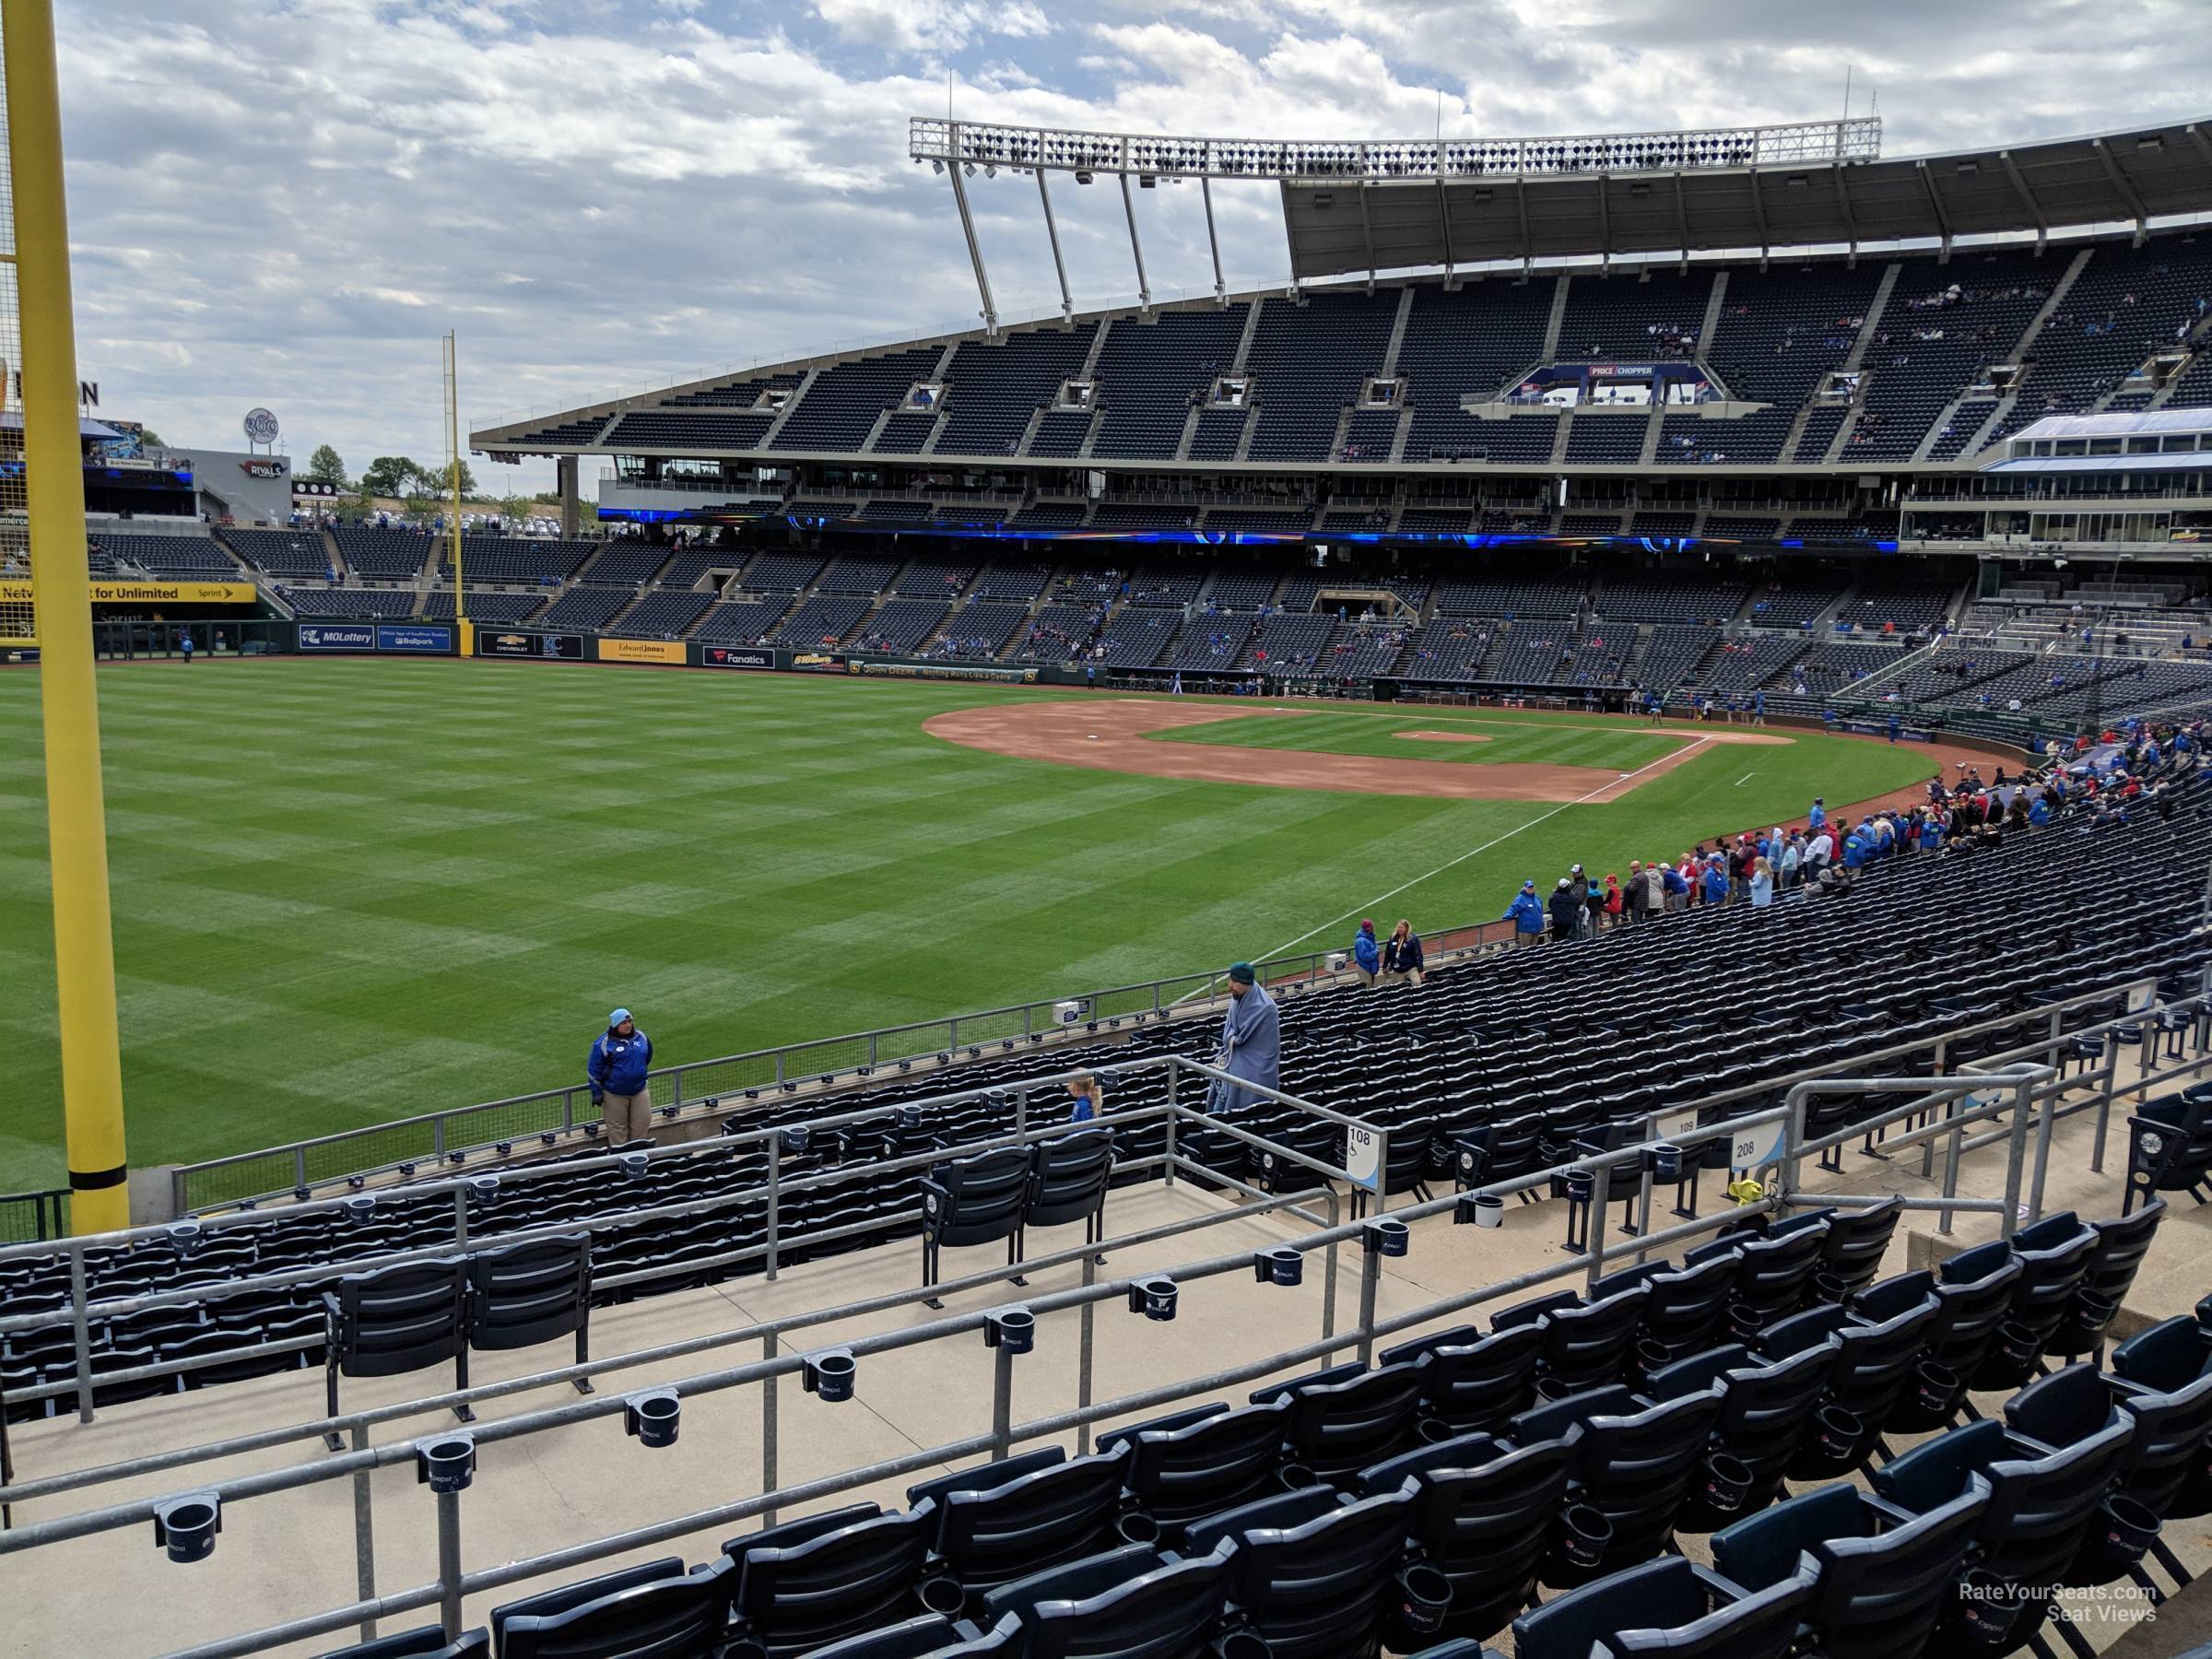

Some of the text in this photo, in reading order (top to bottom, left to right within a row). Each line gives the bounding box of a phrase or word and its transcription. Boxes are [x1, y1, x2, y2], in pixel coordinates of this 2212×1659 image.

[1592, 367, 1614, 375] PRICE
[246, 414, 278, 437] 360
[251, 465, 282, 477] RIVALS
[95, 587, 113, 599] for
[116, 587, 179, 599] Unlimited
[198, 589, 222, 599] Sprint
[323, 631, 372, 644] MOLottery
[403, 637, 433, 645] Ballpark
[618, 642, 665, 653] Edward Jones
[727, 653, 766, 665] Fanatics
[1679, 1121, 1694, 1134] 109
[1350, 1127, 1371, 1146] 108
[1736, 1141, 1755, 1159] 208
